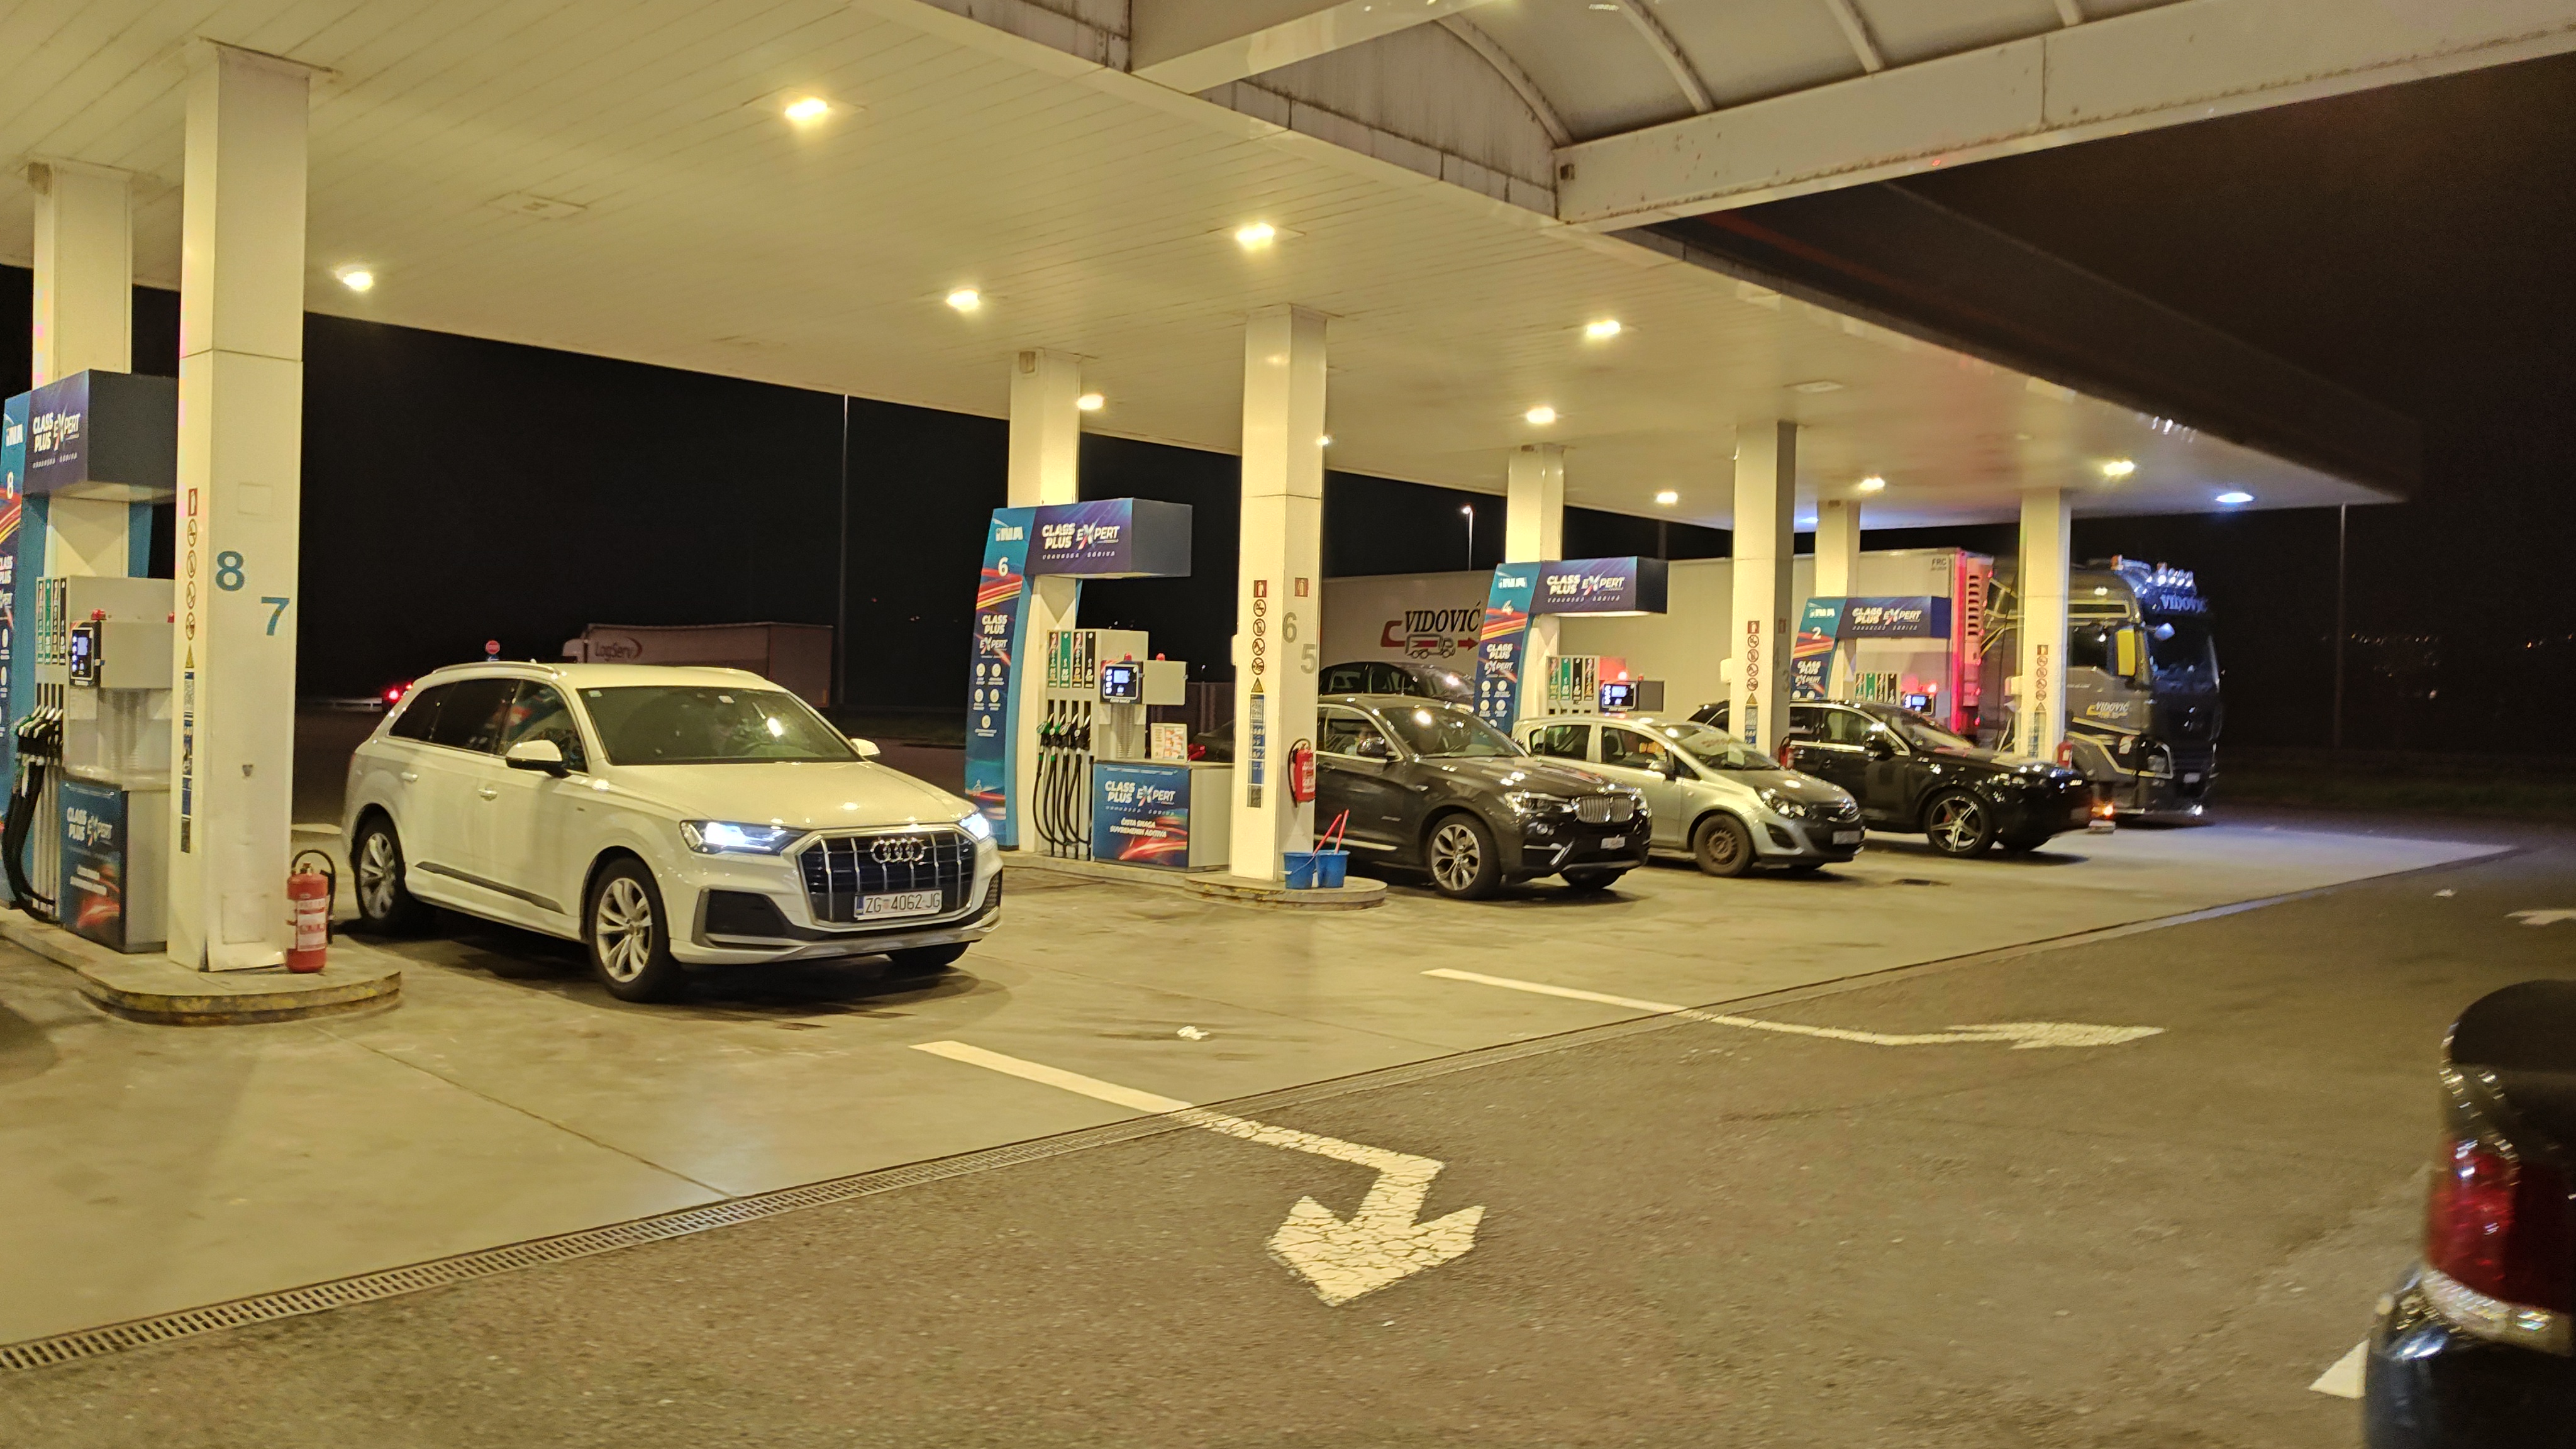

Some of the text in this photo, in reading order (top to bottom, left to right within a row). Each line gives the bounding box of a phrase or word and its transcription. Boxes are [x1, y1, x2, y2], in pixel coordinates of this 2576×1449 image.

[33, 411, 54, 435] CLASS
[53, 409, 81, 452] EXPERT
[34, 431, 52, 453] PLUS
[7, 470, 14, 500] 8
[1042, 523, 1076, 538] CLASS
[1075, 522, 1121, 550] EXPERT
[1044, 535, 1072, 550] PLUS
[216, 550, 245, 592] 8
[998, 557, 1009, 577] 6
[1546, 574, 1581, 586] CLASS
[1549, 584, 1577, 595] PLUS
[1580, 574, 1625, 596] EXPERT
[261, 596, 290, 636] 7
[982, 614, 1008, 626] CLASS
[1405, 601, 1481, 633] VIDOVIĆ
[1852, 607, 1882, 618] CLASS
[1855, 615, 1880, 625] PLUS
[984, 624, 1005, 635] PLUS
[1282, 611, 1297, 643] 6
[1812, 626, 1821, 640] 2
[979, 636, 1008, 655] EXPERT
[1487, 643, 1513, 653] CLASS
[1301, 643, 1316, 674] 5
[1105, 780, 1136, 793] CLASS
[1136, 784, 1176, 807] EXPERT
[1107, 791, 1132, 804] PLUS
[67, 806, 87, 826] CLASS
